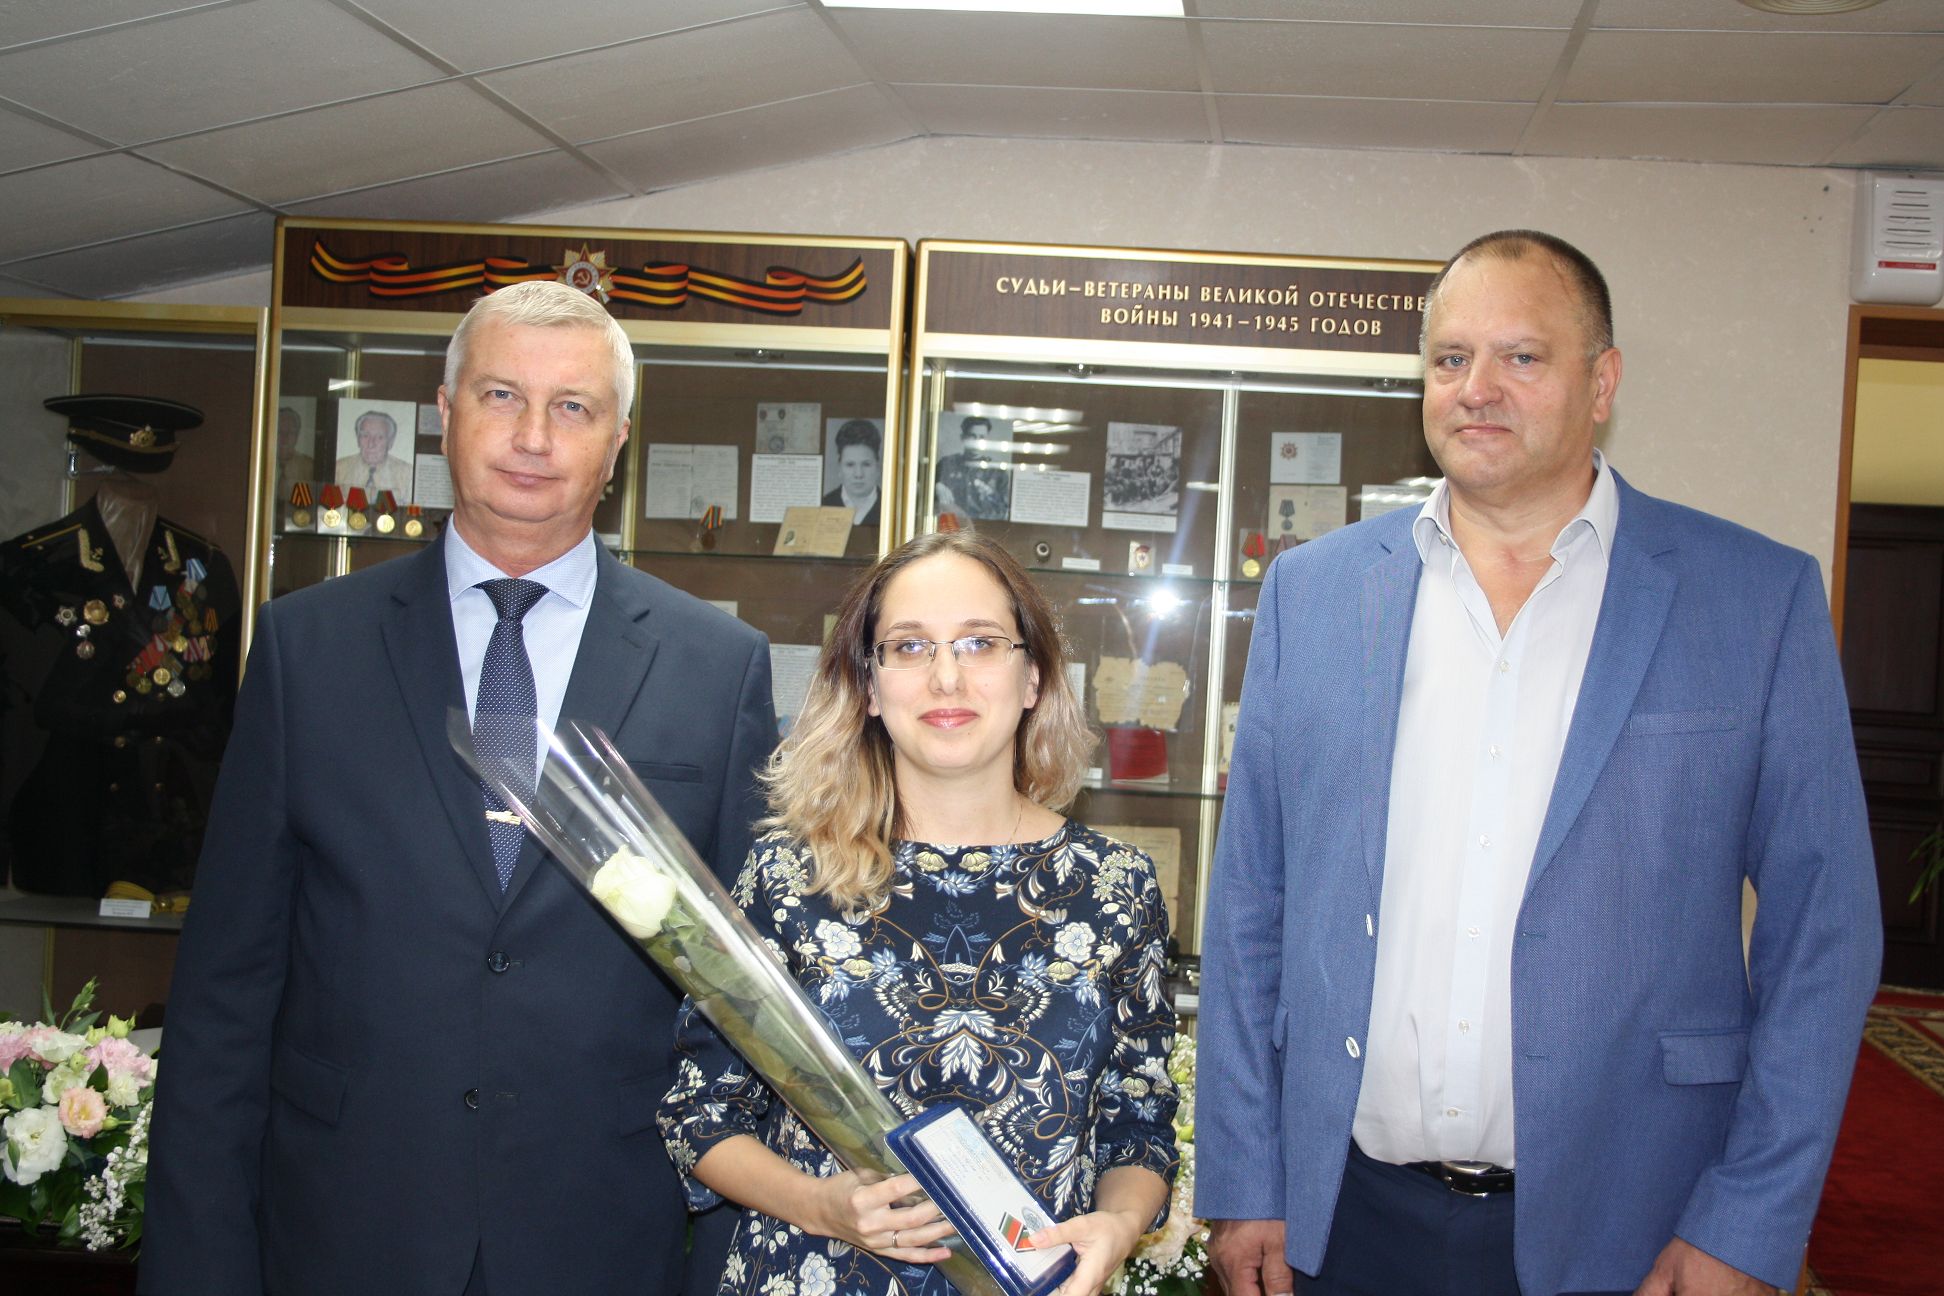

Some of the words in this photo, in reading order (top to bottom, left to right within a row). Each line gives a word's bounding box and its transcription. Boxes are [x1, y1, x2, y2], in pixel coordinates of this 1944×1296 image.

[1201, 285, 1298, 306] ВЕЛИКОЙ
[1309, 291, 1425, 312] ОТЕЧЕСТВЕ
[1101, 304, 1178, 326] ВОЙНЫ
[1310, 317, 1381, 336] ГОДОВ
